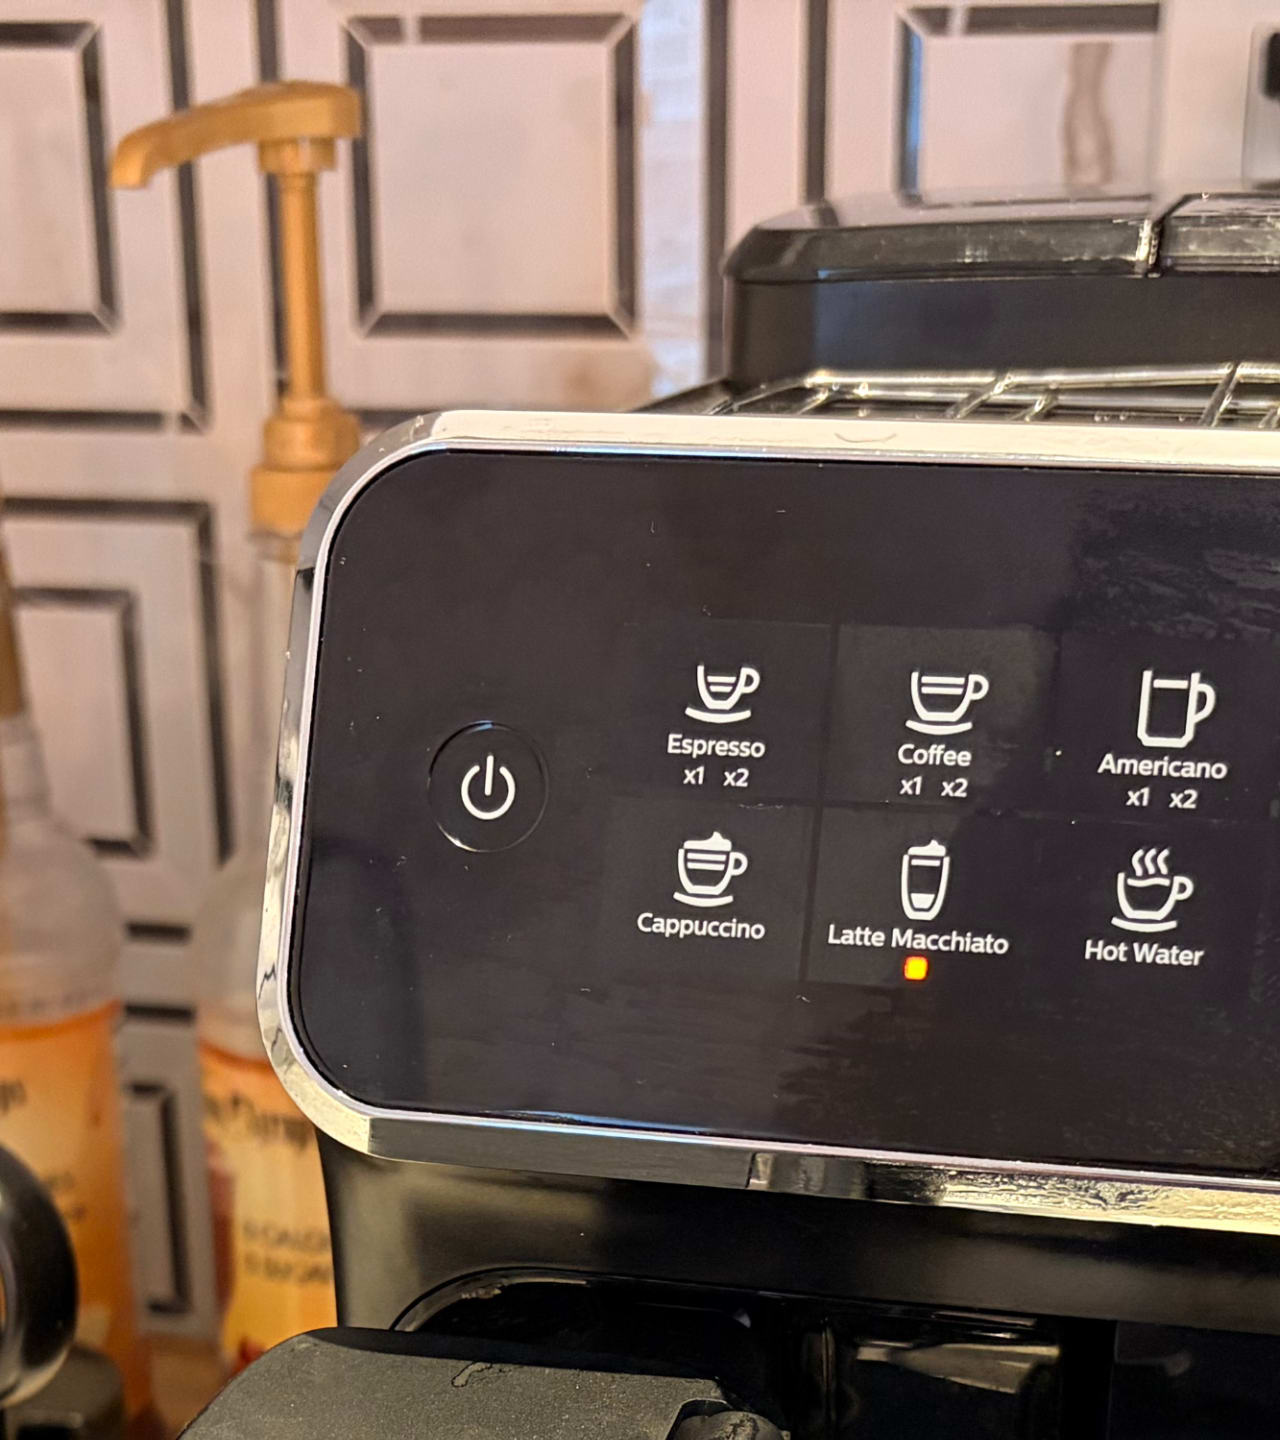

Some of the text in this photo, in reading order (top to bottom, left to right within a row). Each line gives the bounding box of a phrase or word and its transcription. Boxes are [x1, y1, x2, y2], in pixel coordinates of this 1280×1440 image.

[666, 732, 767, 760] Espresso
[896, 742, 973, 768] Coffee
[682, 764, 750, 788] x1 x2
[1096, 752, 1229, 780] Americano
[898, 775, 969, 799] x1 x2
[1125, 786, 1199, 810] x1 x2
[636, 911, 767, 941] Cappuccino
[827, 923, 1010, 955] Latte Macchiato
[1083, 938, 1205, 967] Hot Water
